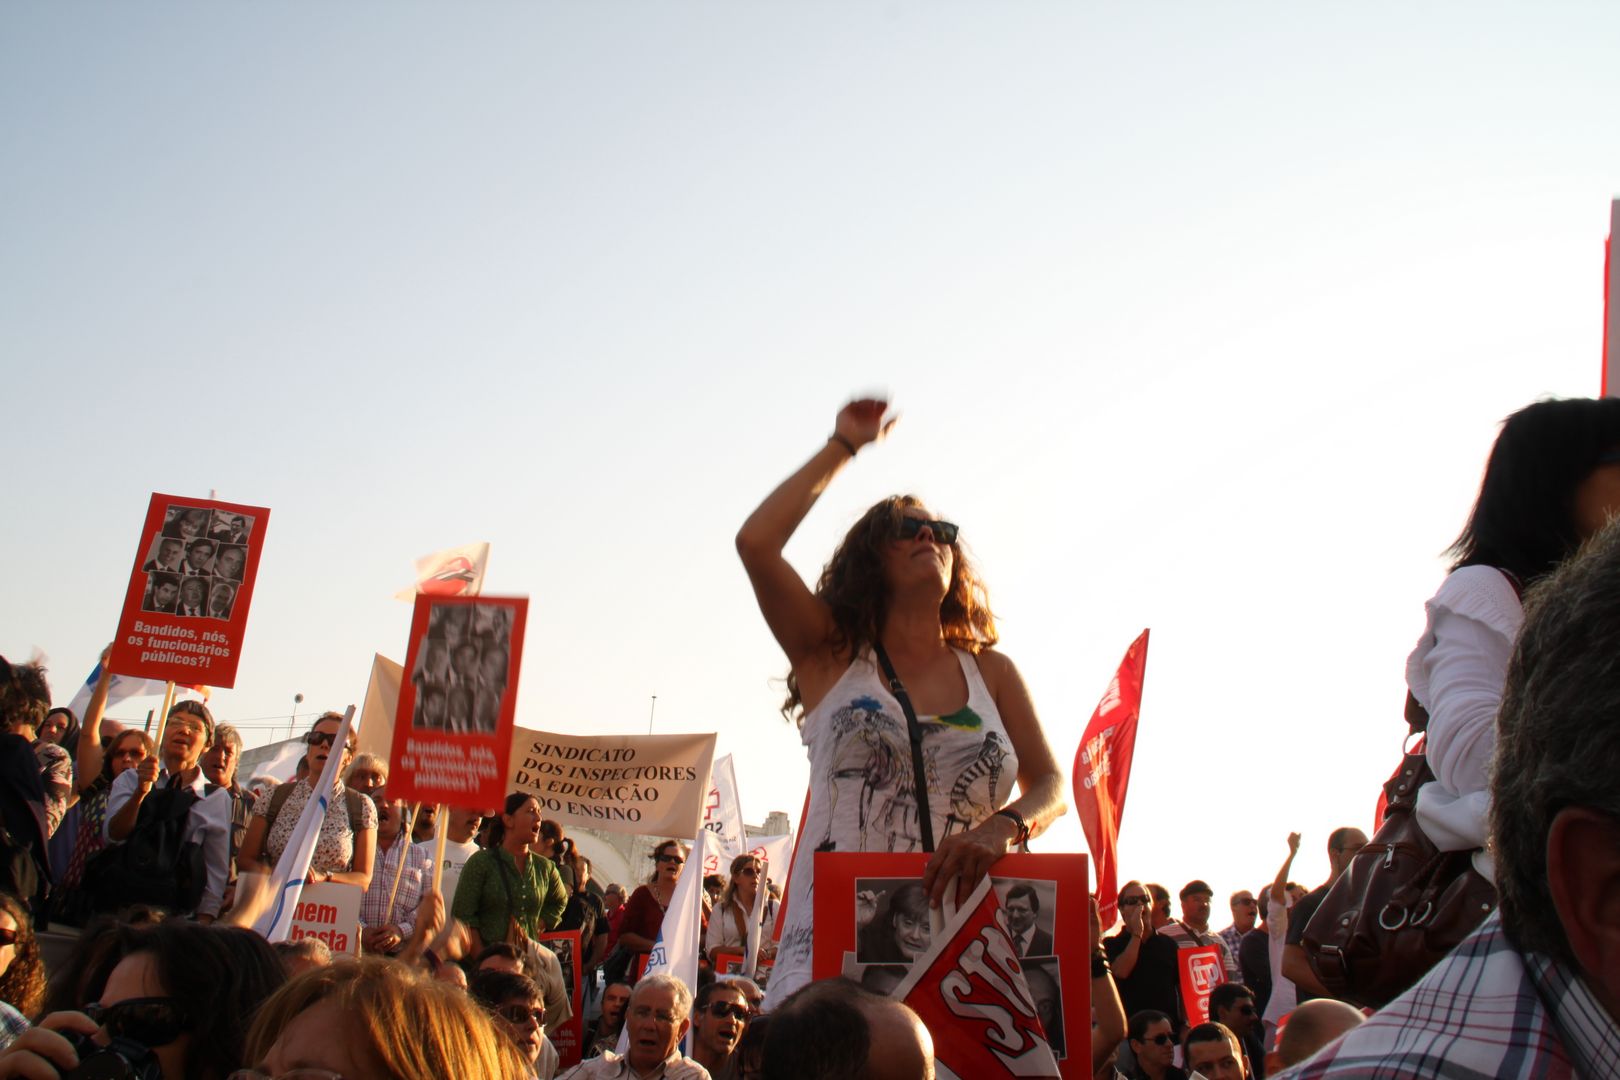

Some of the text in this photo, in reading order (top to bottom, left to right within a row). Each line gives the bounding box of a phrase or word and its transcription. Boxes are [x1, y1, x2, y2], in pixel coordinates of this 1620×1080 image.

[134, 620, 229, 645] Bandidos, nós,
[127, 635, 230, 657] os funcionários
[140, 650, 211, 668] públicos?!
[530, 741, 636, 762] SINDICATO
[522, 757, 697, 782] DOS INSPECTORES
[515, 770, 659, 805] DA EDUCAÇÃO
[567, 801, 642, 823] ENSINO
[293, 902, 338, 924] nem
